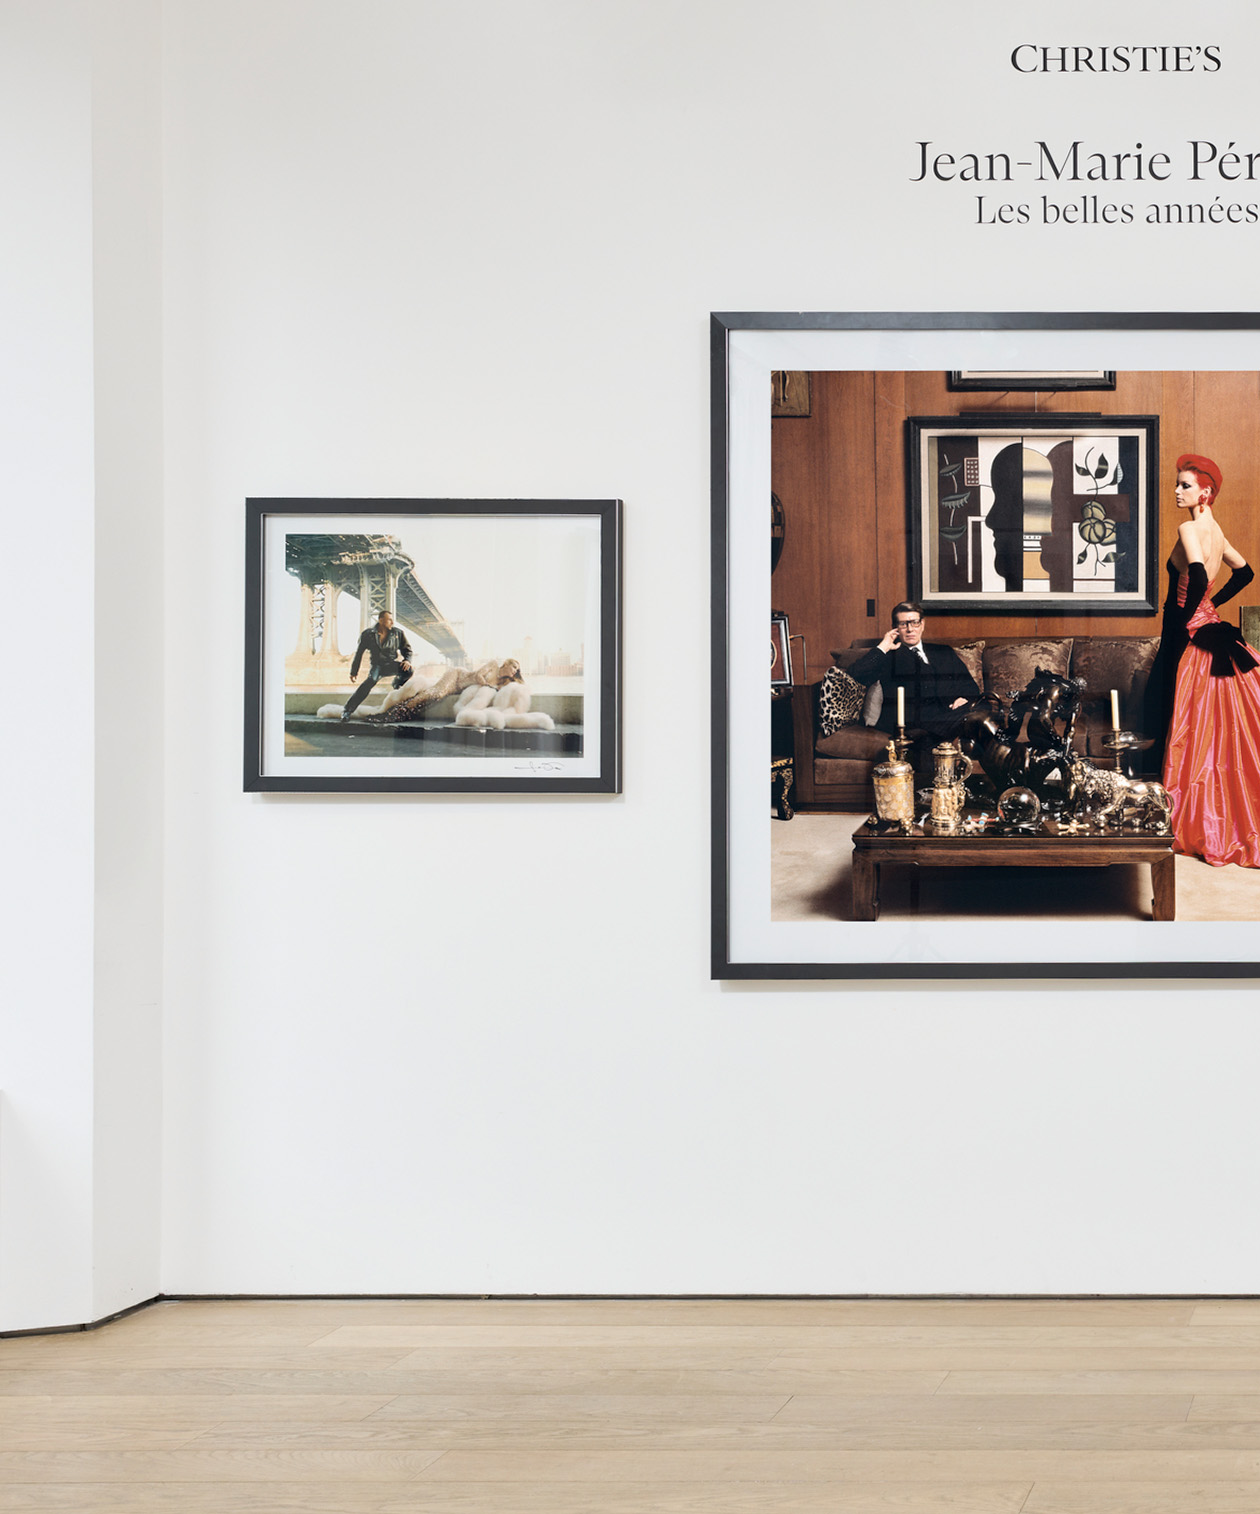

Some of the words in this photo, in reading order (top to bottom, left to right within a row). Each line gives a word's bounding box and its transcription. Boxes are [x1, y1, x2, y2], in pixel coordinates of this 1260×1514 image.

[1010, 44, 1222, 73] CHRISTIE'S
[909, 140, 1172, 182] Jean-Marie
[975, 195, 1031, 224] Les
[1040, 195, 1135, 224] belles
[1145, 195, 1260, 224] années
